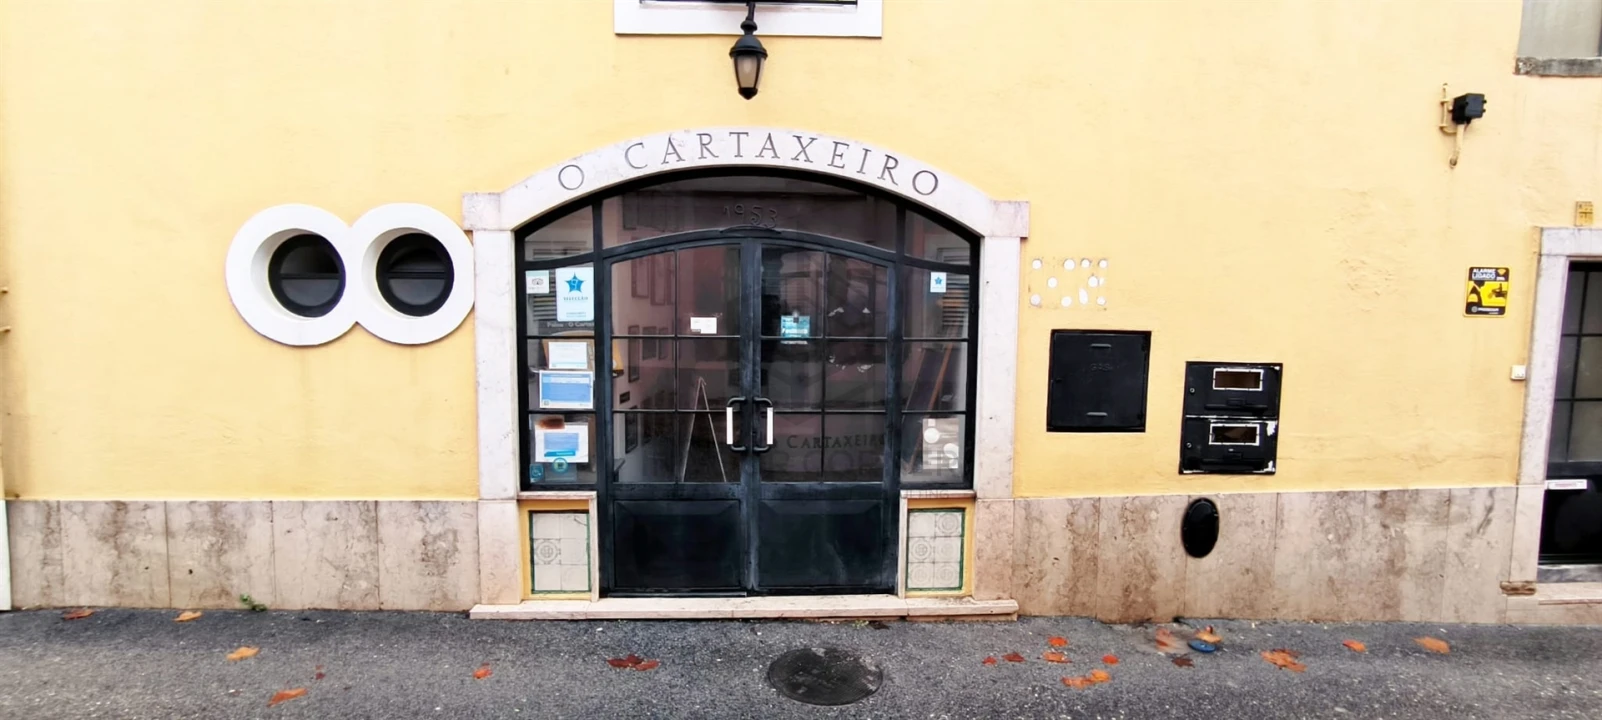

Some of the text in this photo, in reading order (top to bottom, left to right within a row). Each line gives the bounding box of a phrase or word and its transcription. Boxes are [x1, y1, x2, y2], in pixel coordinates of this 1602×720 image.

[557, 131, 939, 197] O CARTAXEIRO
[723, 203, 777, 229] 1953
